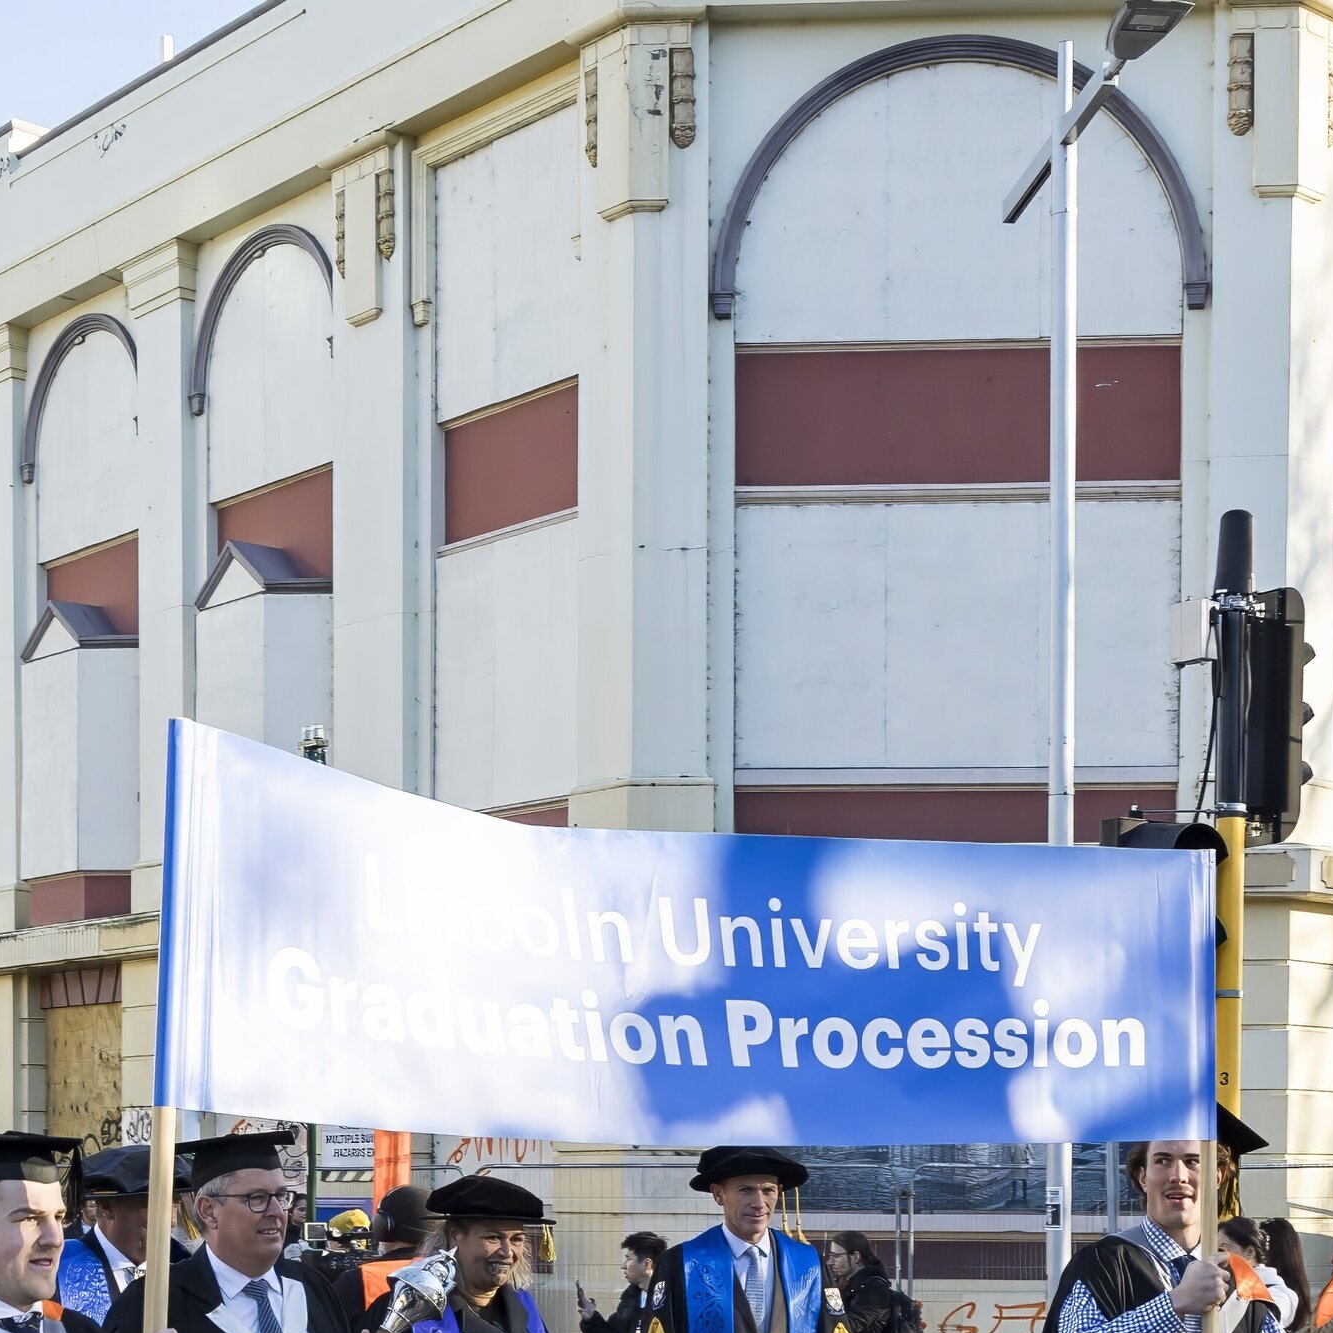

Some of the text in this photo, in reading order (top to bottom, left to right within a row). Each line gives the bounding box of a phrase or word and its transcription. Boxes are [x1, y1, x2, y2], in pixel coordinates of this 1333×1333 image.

[365, 852, 1042, 988] Lcoln University
[266, 945, 1146, 1069] Graduation Procession
[1219, 1071, 1229, 1086] 3
